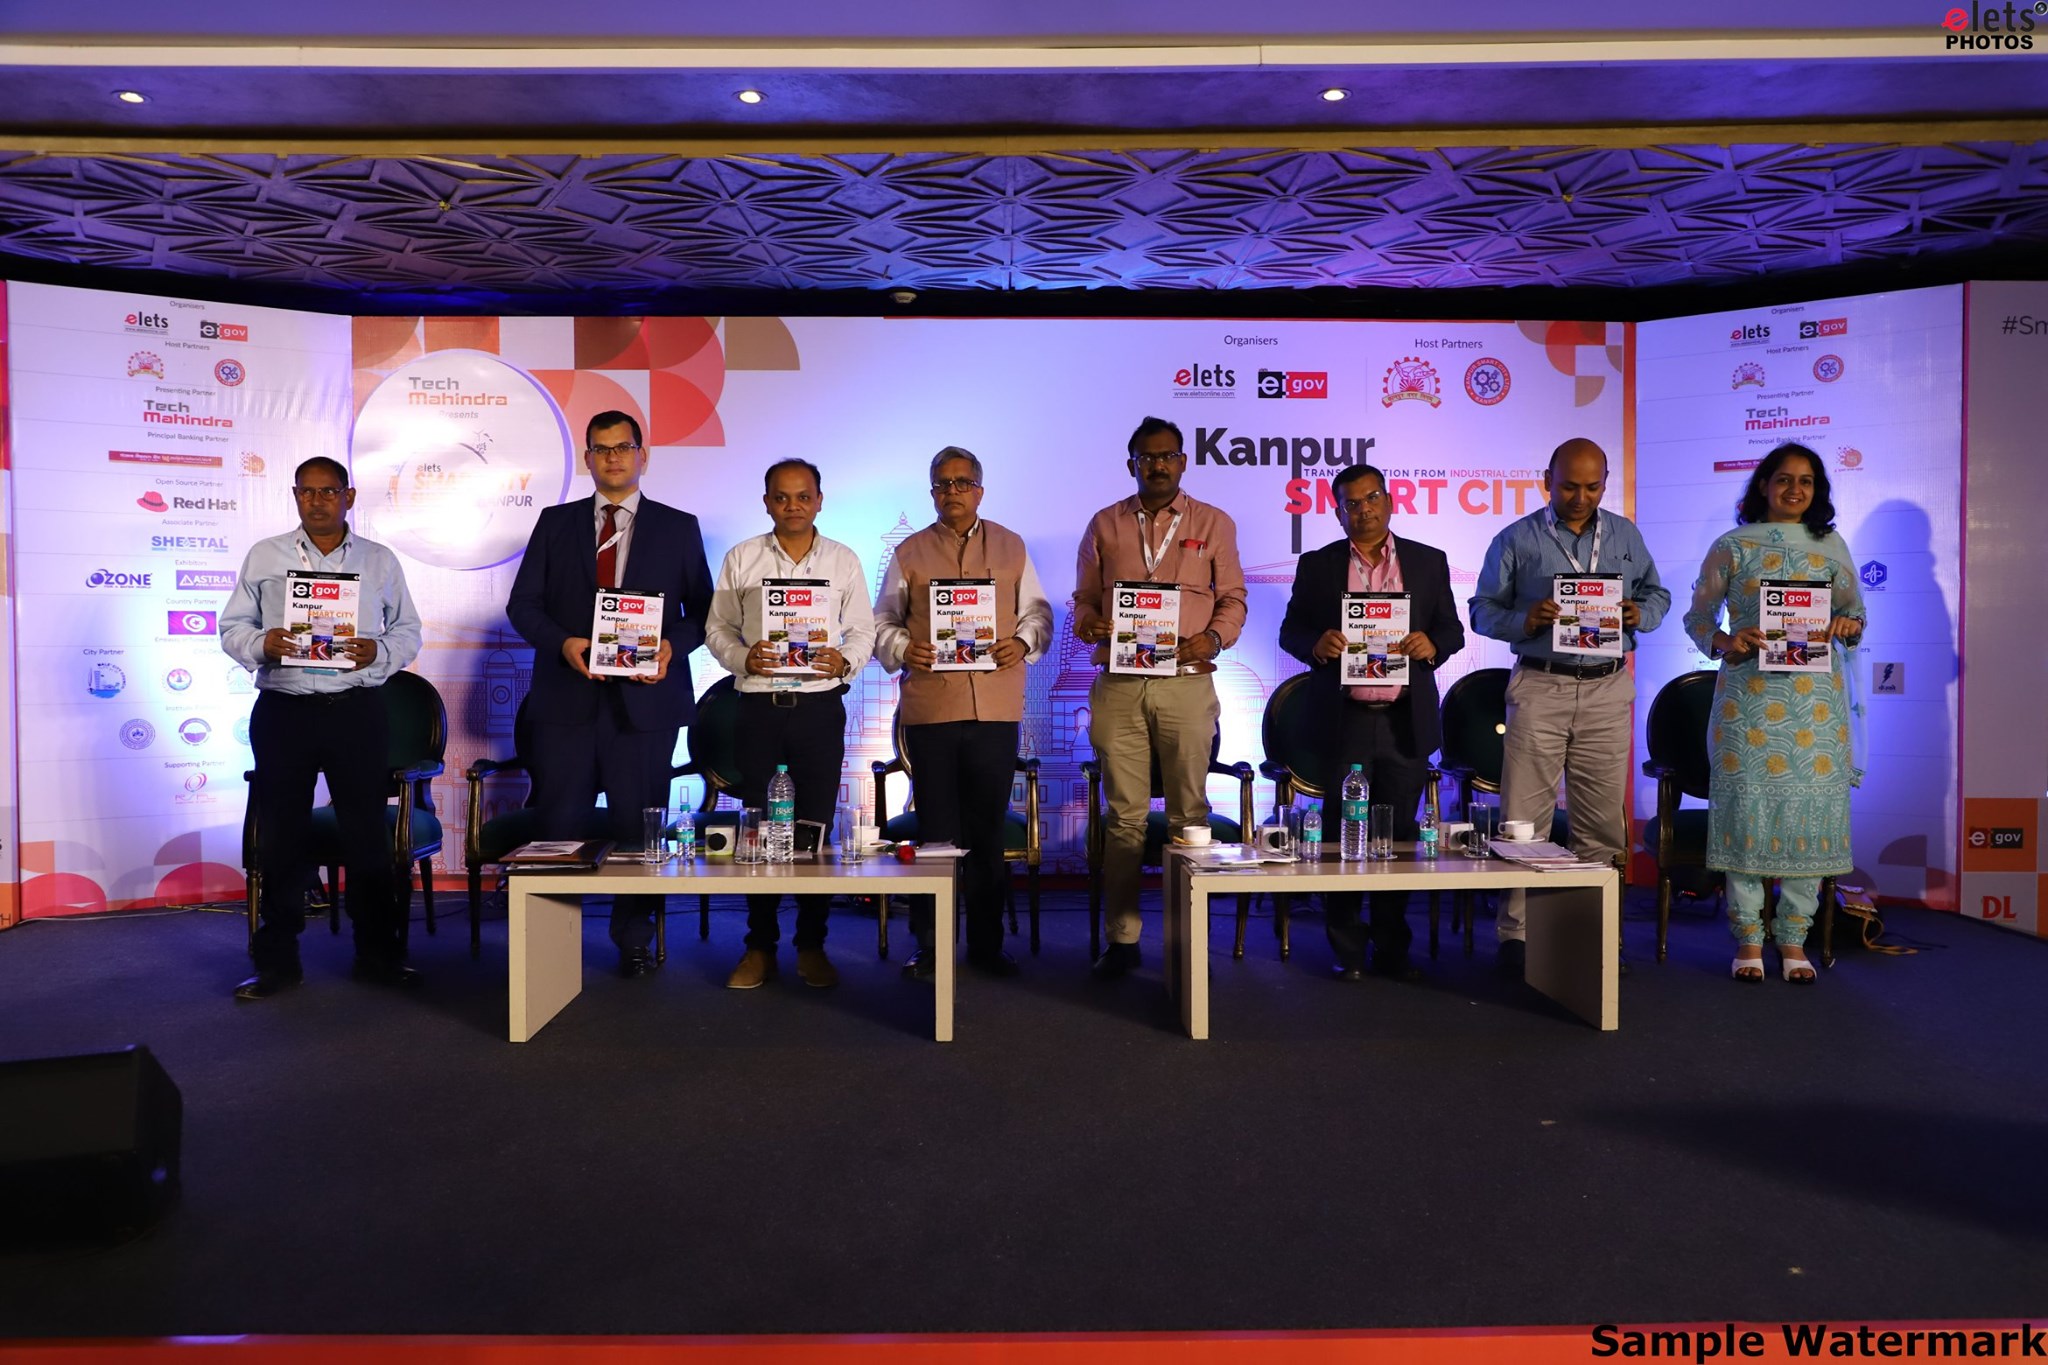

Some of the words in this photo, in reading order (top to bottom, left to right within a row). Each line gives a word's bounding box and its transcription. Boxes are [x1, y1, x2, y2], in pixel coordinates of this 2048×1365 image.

[124, 311, 169, 328] elets
[1730, 323, 1770, 340] elets
[165, 340, 181, 349] Host
[182, 342, 211, 351] Partners
[1223, 335, 1279, 348] Organisers
[1414, 338, 1439, 349] Host
[1440, 339, 1483, 350] Partners
[1766, 347, 1782, 355] Host
[1783, 345, 1809, 353] Partners
[1173, 362, 1236, 388] elets
[408, 377, 460, 391] Tech
[155, 386, 191, 396] Presenting
[192, 389, 217, 397] Partner
[1757, 392, 1790, 401] Presenting
[1790, 389, 1814, 398] Partner
[408, 392, 508, 406] Mahindra
[143, 399, 190, 413] Tech
[1745, 406, 1788, 419] Tech
[143, 411, 233, 428] Mahindra
[1745, 415, 1831, 431] Mahindra
[147, 431, 176, 441] Principal
[177, 433, 204, 442] Banking
[205, 434, 229, 443] Partner
[1748, 438, 1775, 446] Principal
[1802, 433, 1826, 442] Partner
[416, 463, 442, 473] elets
[1413, 468, 1446, 478] FROM
[1449, 469, 1507, 478] INDUSTRIAL
[1509, 469, 1531, 478] CITY
[155, 478, 174, 487] Open
[175, 479, 198, 487] Source
[1284, 477, 1449, 516] SMRT
[173, 497, 206, 511] Red
[208, 499, 237, 512] Hat
[161, 519, 193, 527] Associate
[151, 535, 229, 550] SHEETAL
[193, 575, 235, 586] ASTRAL
[1601, 605, 1619, 613] CITY
[809, 616, 827, 624] CITY
[1808, 617, 1826, 625] CITY
[640, 623, 658, 631] CITY
[1388, 629, 1406, 637] CITY
[83, 649, 98, 657] City
[99, 648, 125, 657] Partner
[1982, 895, 2018, 920] DL
